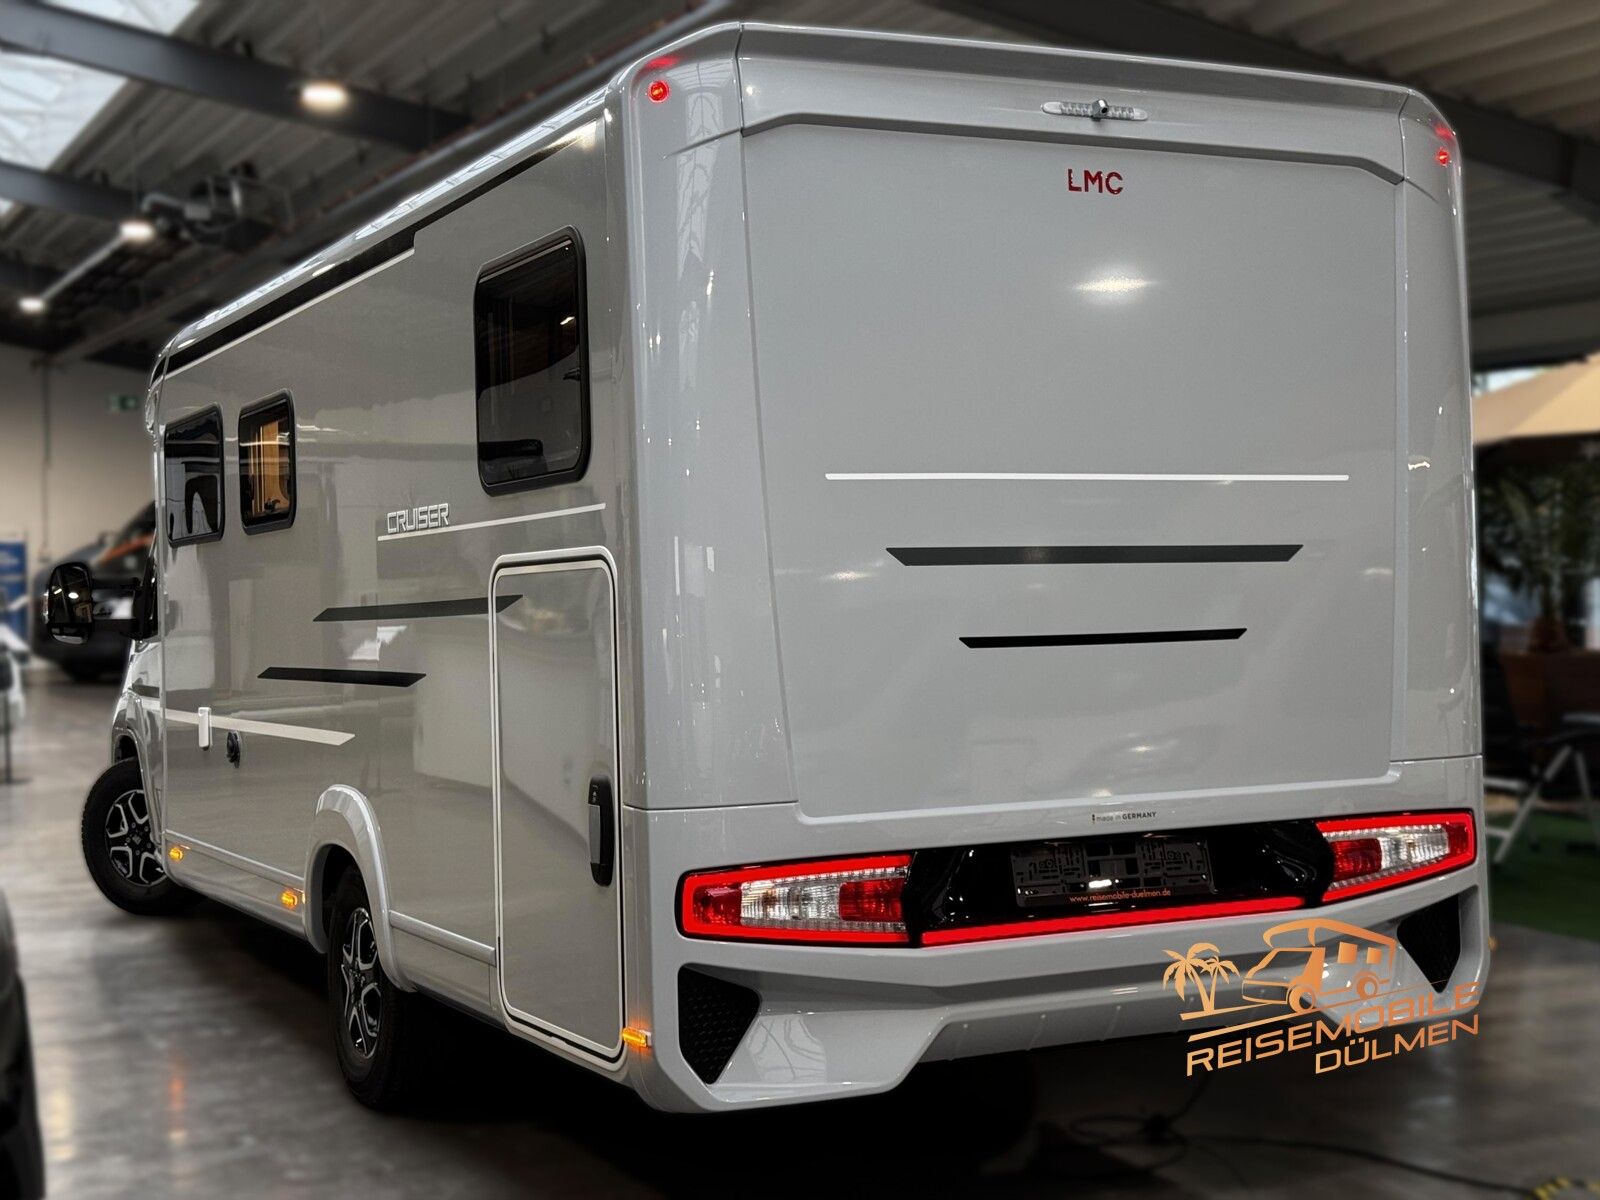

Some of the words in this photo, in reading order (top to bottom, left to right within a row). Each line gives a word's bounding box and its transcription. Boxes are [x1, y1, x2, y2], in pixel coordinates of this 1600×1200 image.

[1067, 168, 1124, 195] LMC
[387, 502, 449, 534] CRUISER
[1122, 811, 1156, 820] GERMANY
